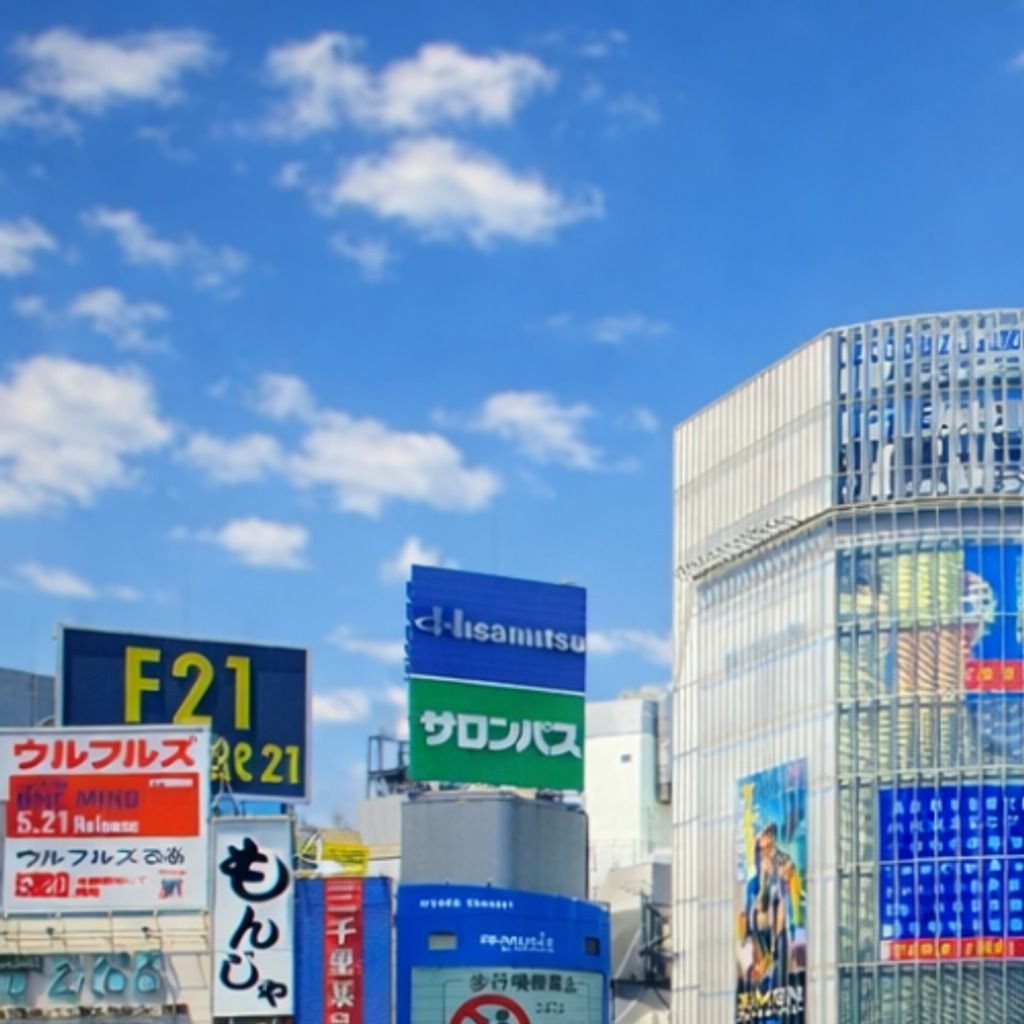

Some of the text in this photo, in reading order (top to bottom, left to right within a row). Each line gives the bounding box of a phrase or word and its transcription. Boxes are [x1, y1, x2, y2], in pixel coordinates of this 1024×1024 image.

[125, 645, 250, 730] F21
[13, 738, 197, 770] ウルフルズ
[420, 710, 582, 759] サロンパス
[261, 743, 299, 784] 21
[17, 810, 69, 834] 5.21
[219, 837, 291, 1008] もんじゃ
